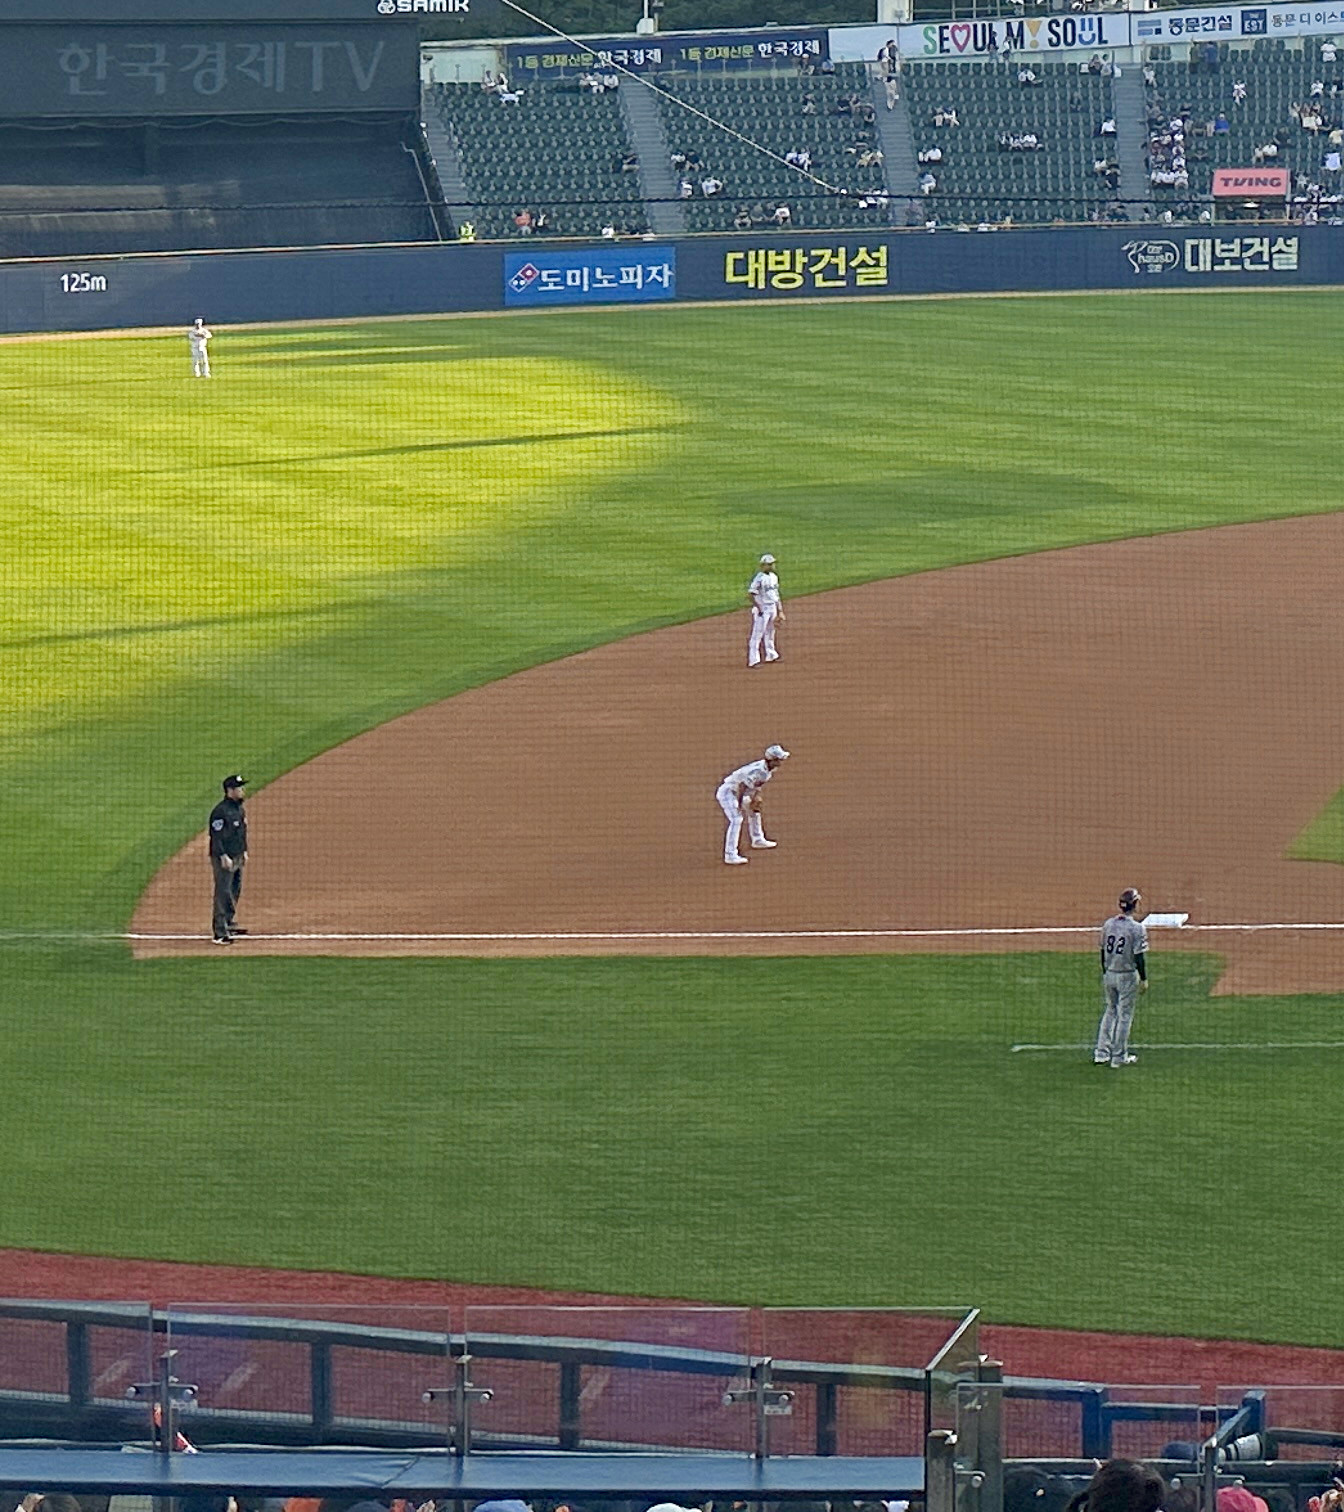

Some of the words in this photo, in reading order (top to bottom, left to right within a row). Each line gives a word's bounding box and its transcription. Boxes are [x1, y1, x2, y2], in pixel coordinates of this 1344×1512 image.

[1169, 15, 1233, 35] 동문건설
[598, 49, 661, 66] 한국경제
[758, 41, 819, 57] 한국경제
[57, 40, 385, 96] 한국경제TV
[1220, 177, 1282, 187] TVING
[725, 244, 888, 289] 대방건설
[1184, 237, 1298, 272] 대보건설
[60, 272, 107, 293] 125m
[538, 263, 673, 291] 도미노피자
